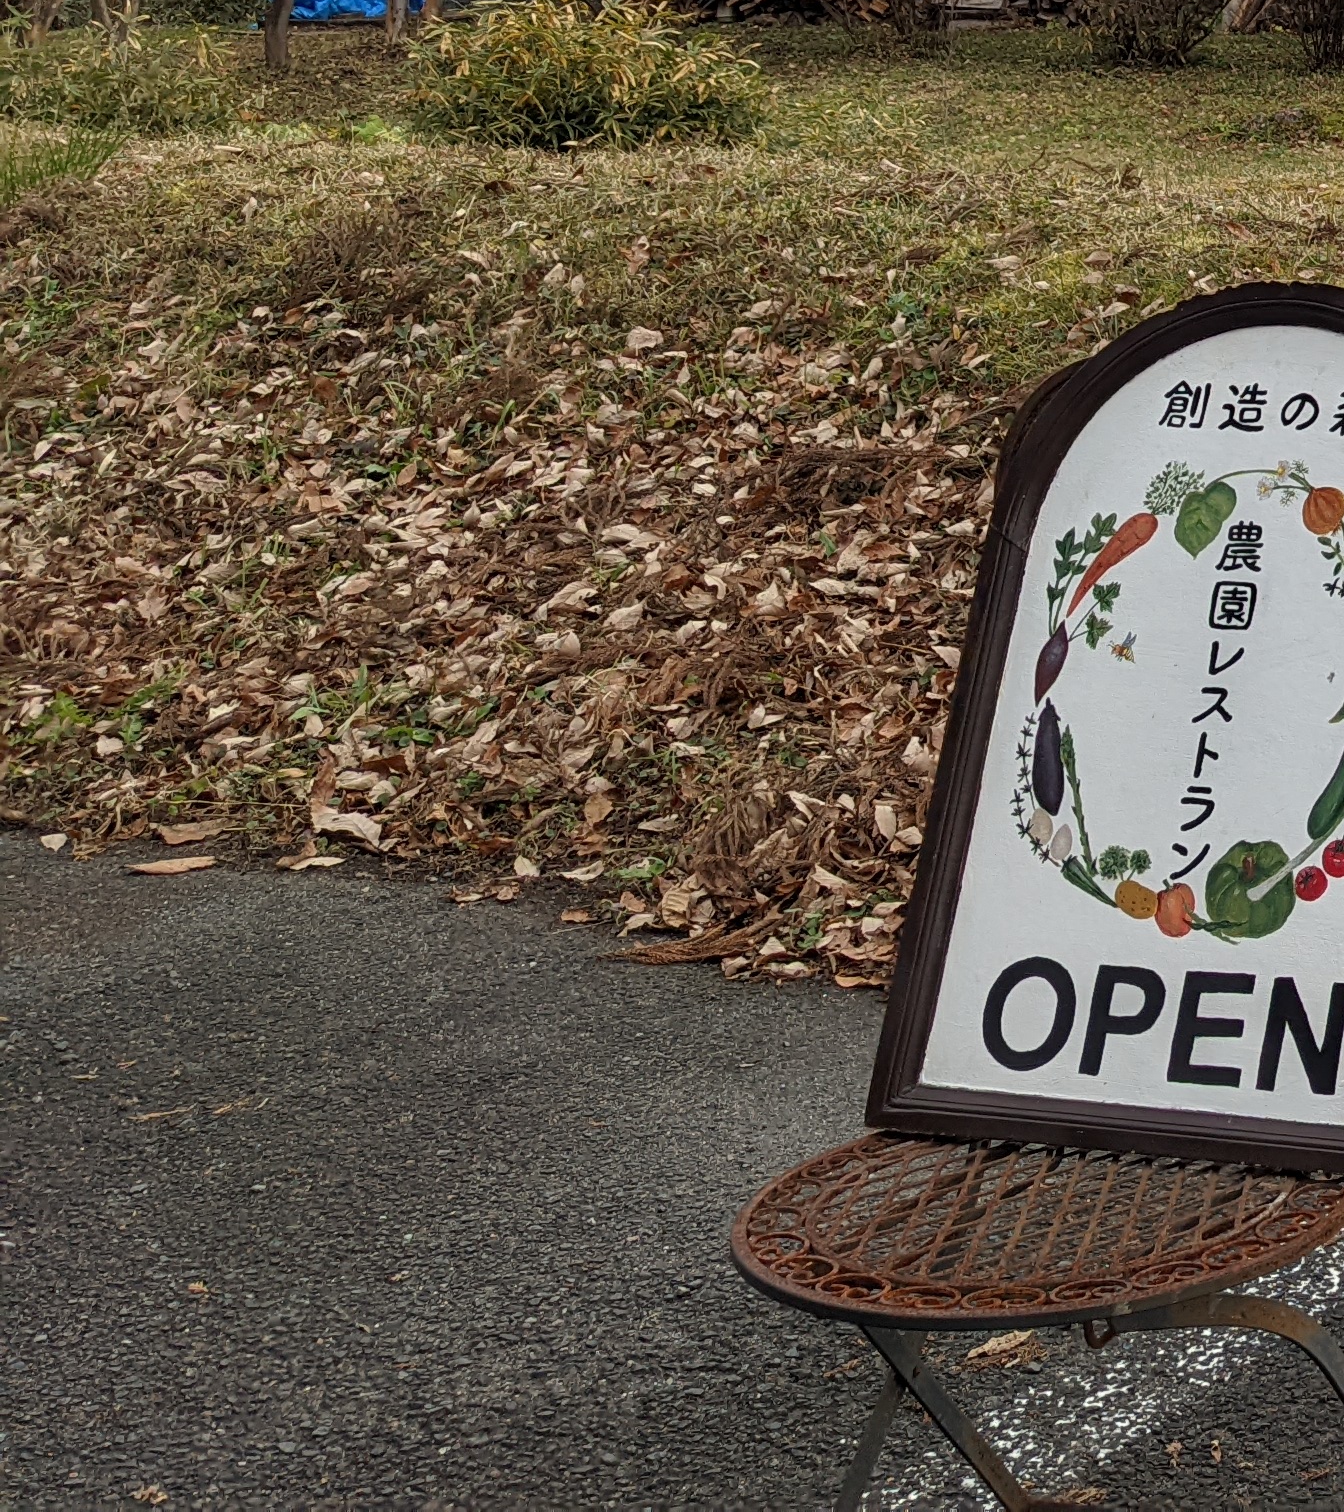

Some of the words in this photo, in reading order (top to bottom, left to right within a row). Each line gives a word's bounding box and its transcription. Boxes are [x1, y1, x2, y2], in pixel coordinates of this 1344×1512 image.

[1168, 520, 1266, 882] 農園レストラン
